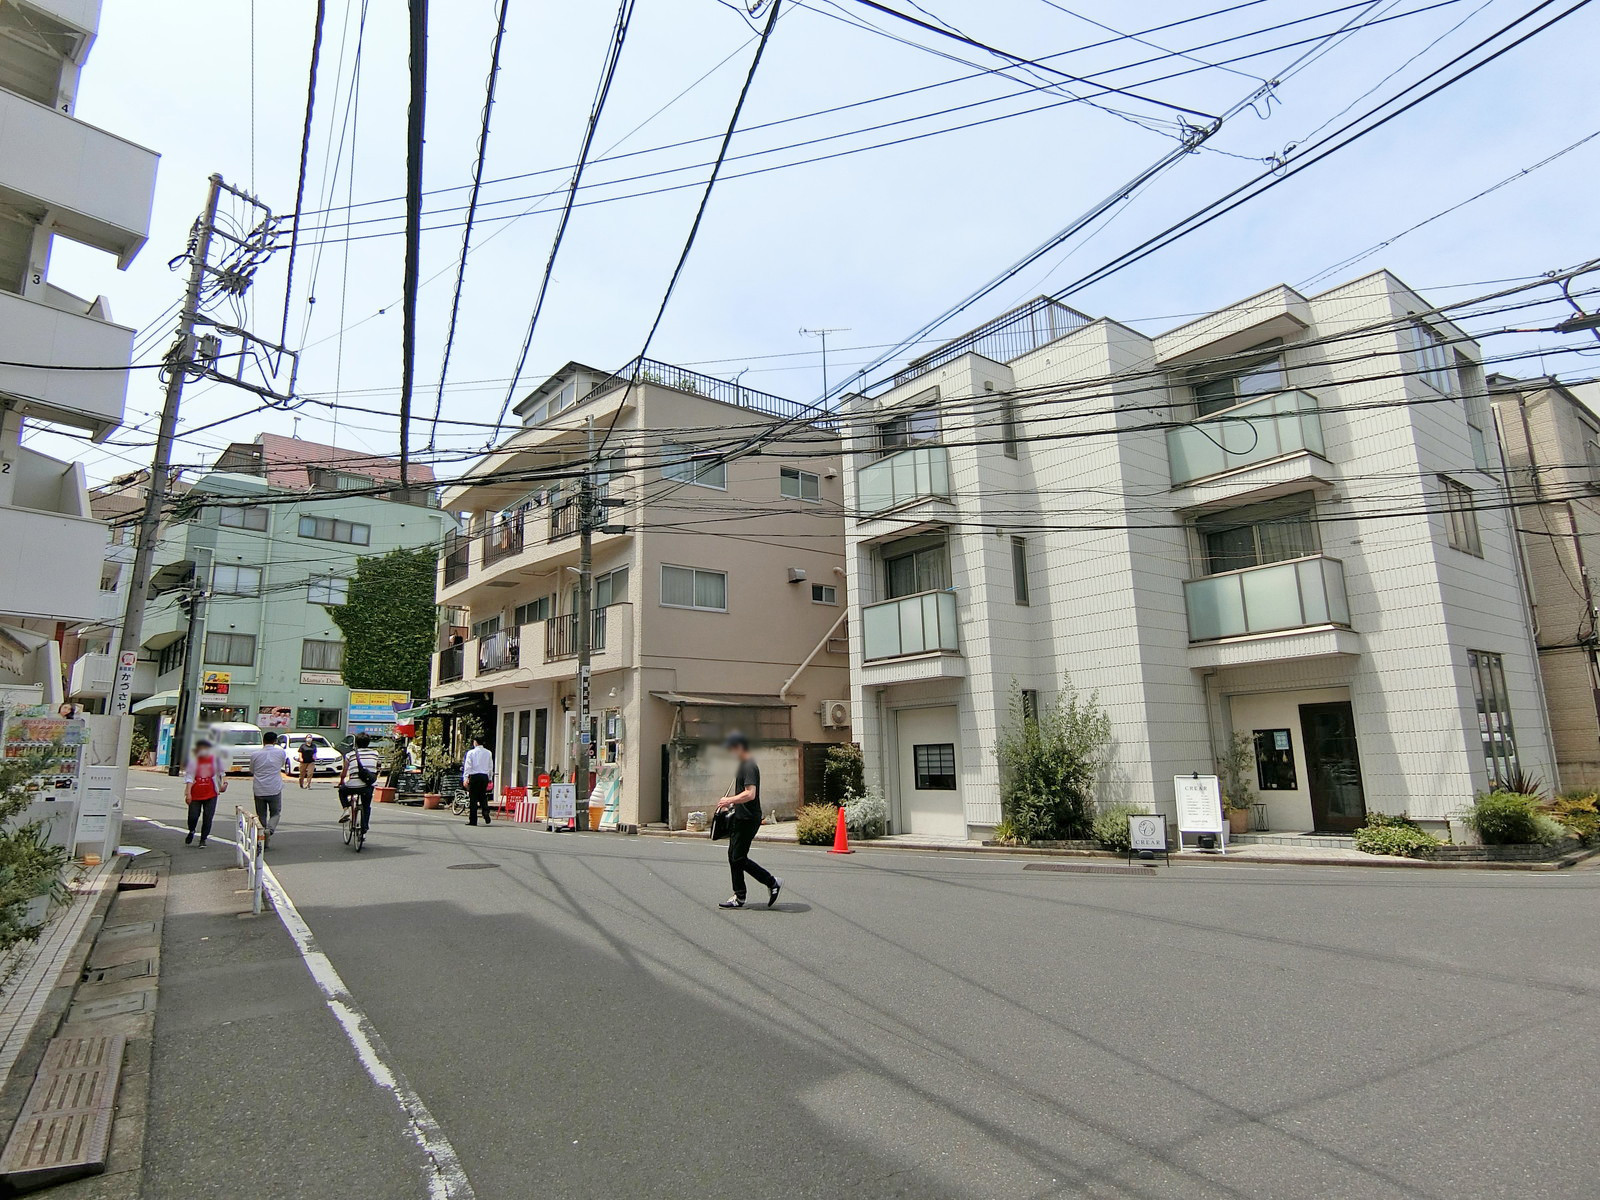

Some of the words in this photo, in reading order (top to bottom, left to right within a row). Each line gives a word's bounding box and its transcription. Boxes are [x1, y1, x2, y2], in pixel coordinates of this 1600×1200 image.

[61, 104, 69, 113] 4
[32, 274, 41, 285] 3
[1, 462, 11, 474] 2
